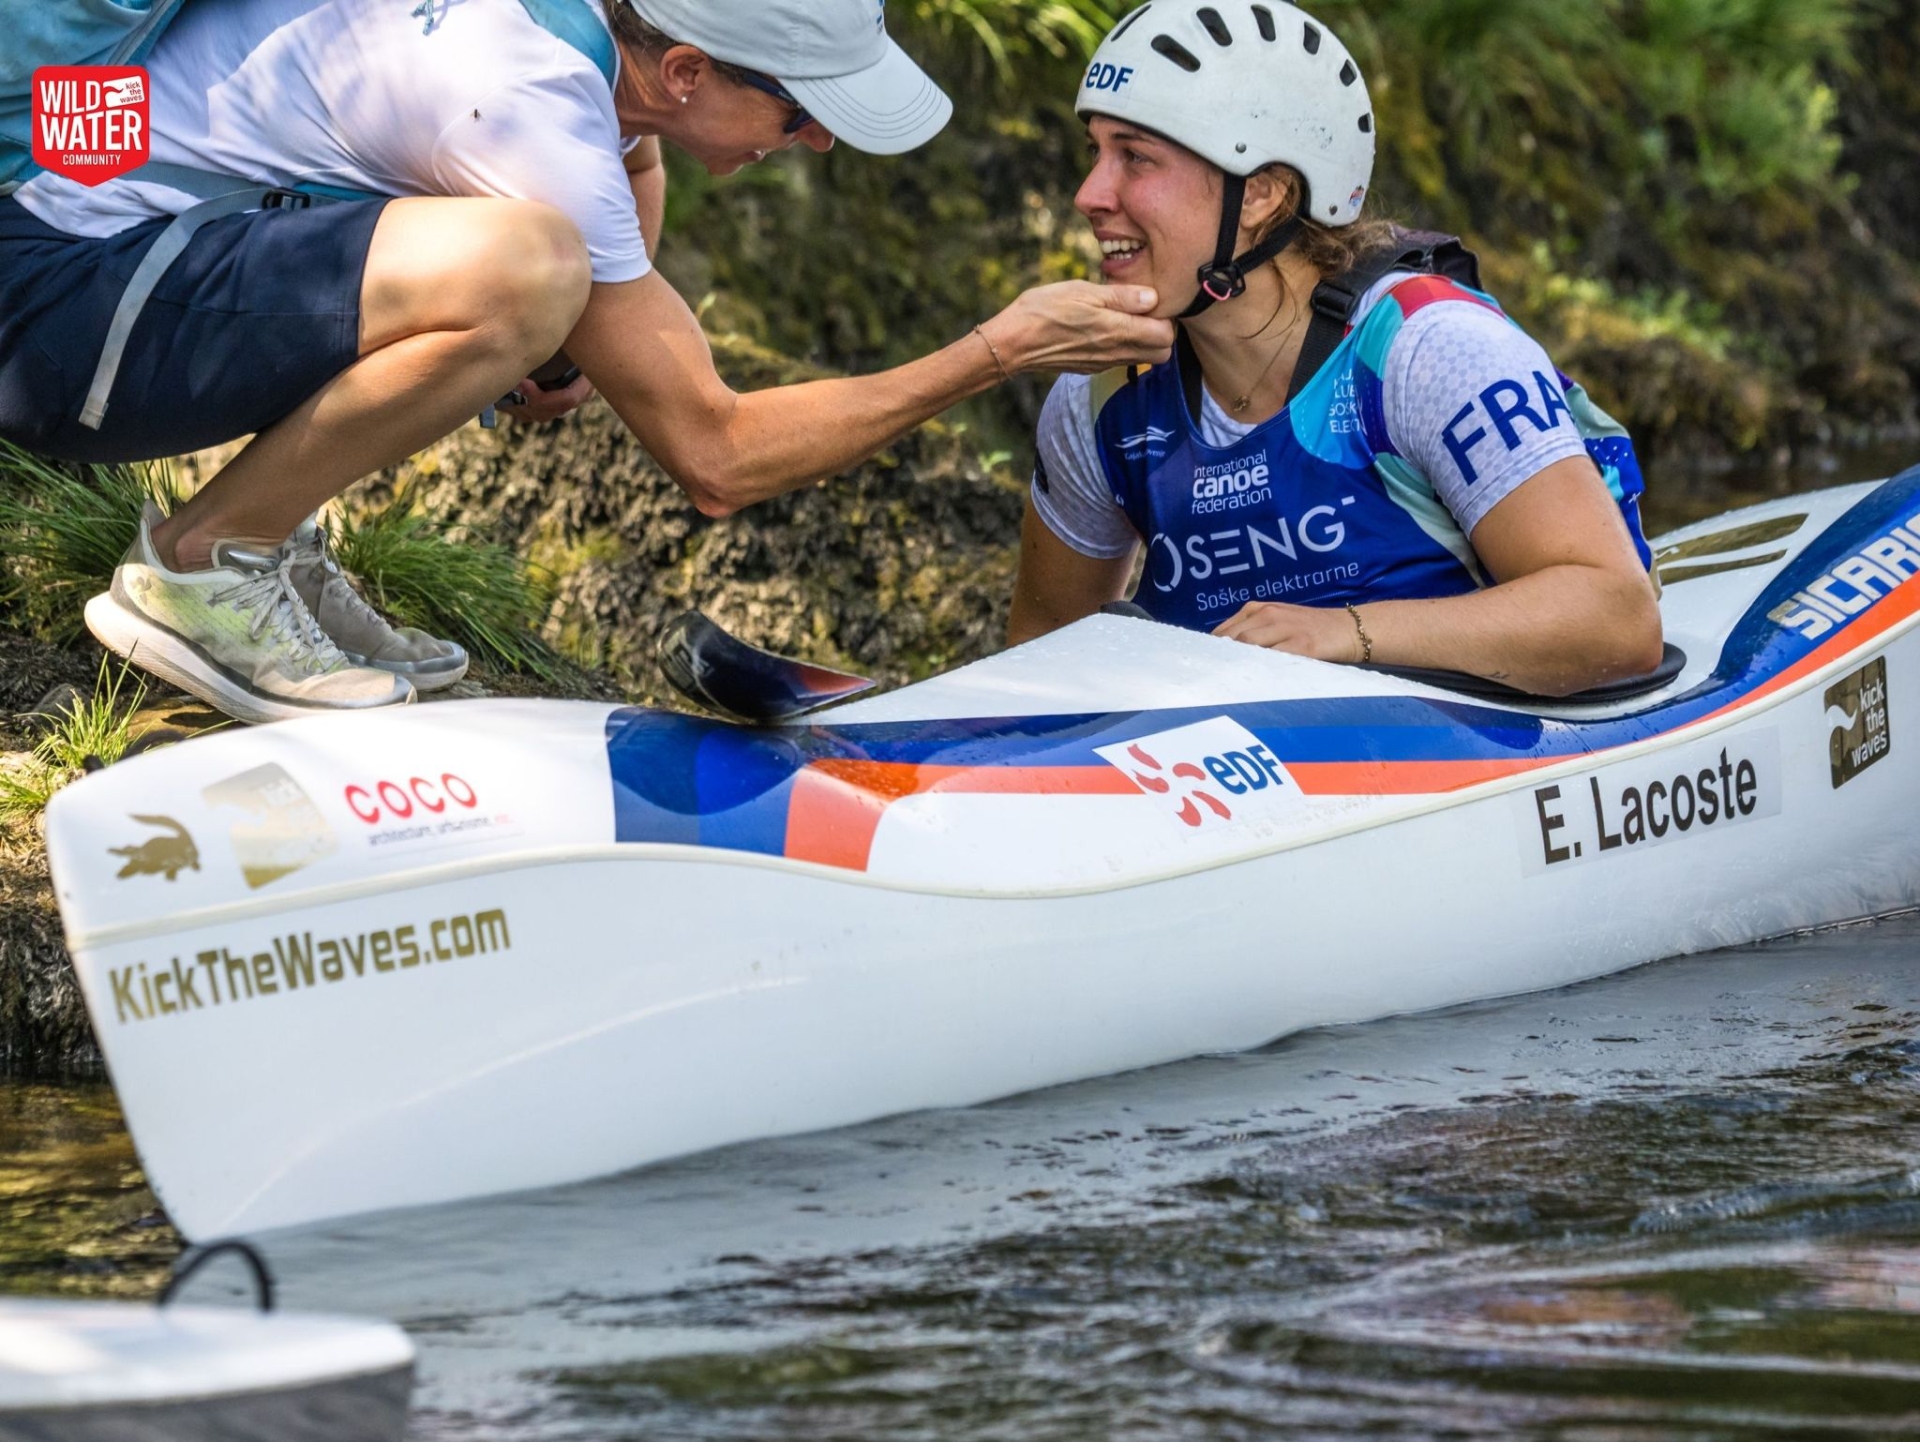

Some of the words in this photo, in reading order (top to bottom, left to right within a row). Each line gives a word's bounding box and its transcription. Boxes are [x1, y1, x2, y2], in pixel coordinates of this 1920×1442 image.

[1441, 370, 1575, 486] FRA
[1193, 449, 1268, 478] international
[1192, 465, 1269, 500] canoe
[1191, 487, 1273, 515] federation
[1196, 586, 1251, 611] Soške
[1255, 561, 1360, 598] elektrarne
[1859, 678, 1885, 713] kick
[1865, 707, 1886, 733] the
[1851, 730, 1888, 768] waves
[1534, 784, 1583, 866] E.
[1589, 746, 1758, 852] Lacoste
[108, 908, 512, 1025] KickTheWaves.com
